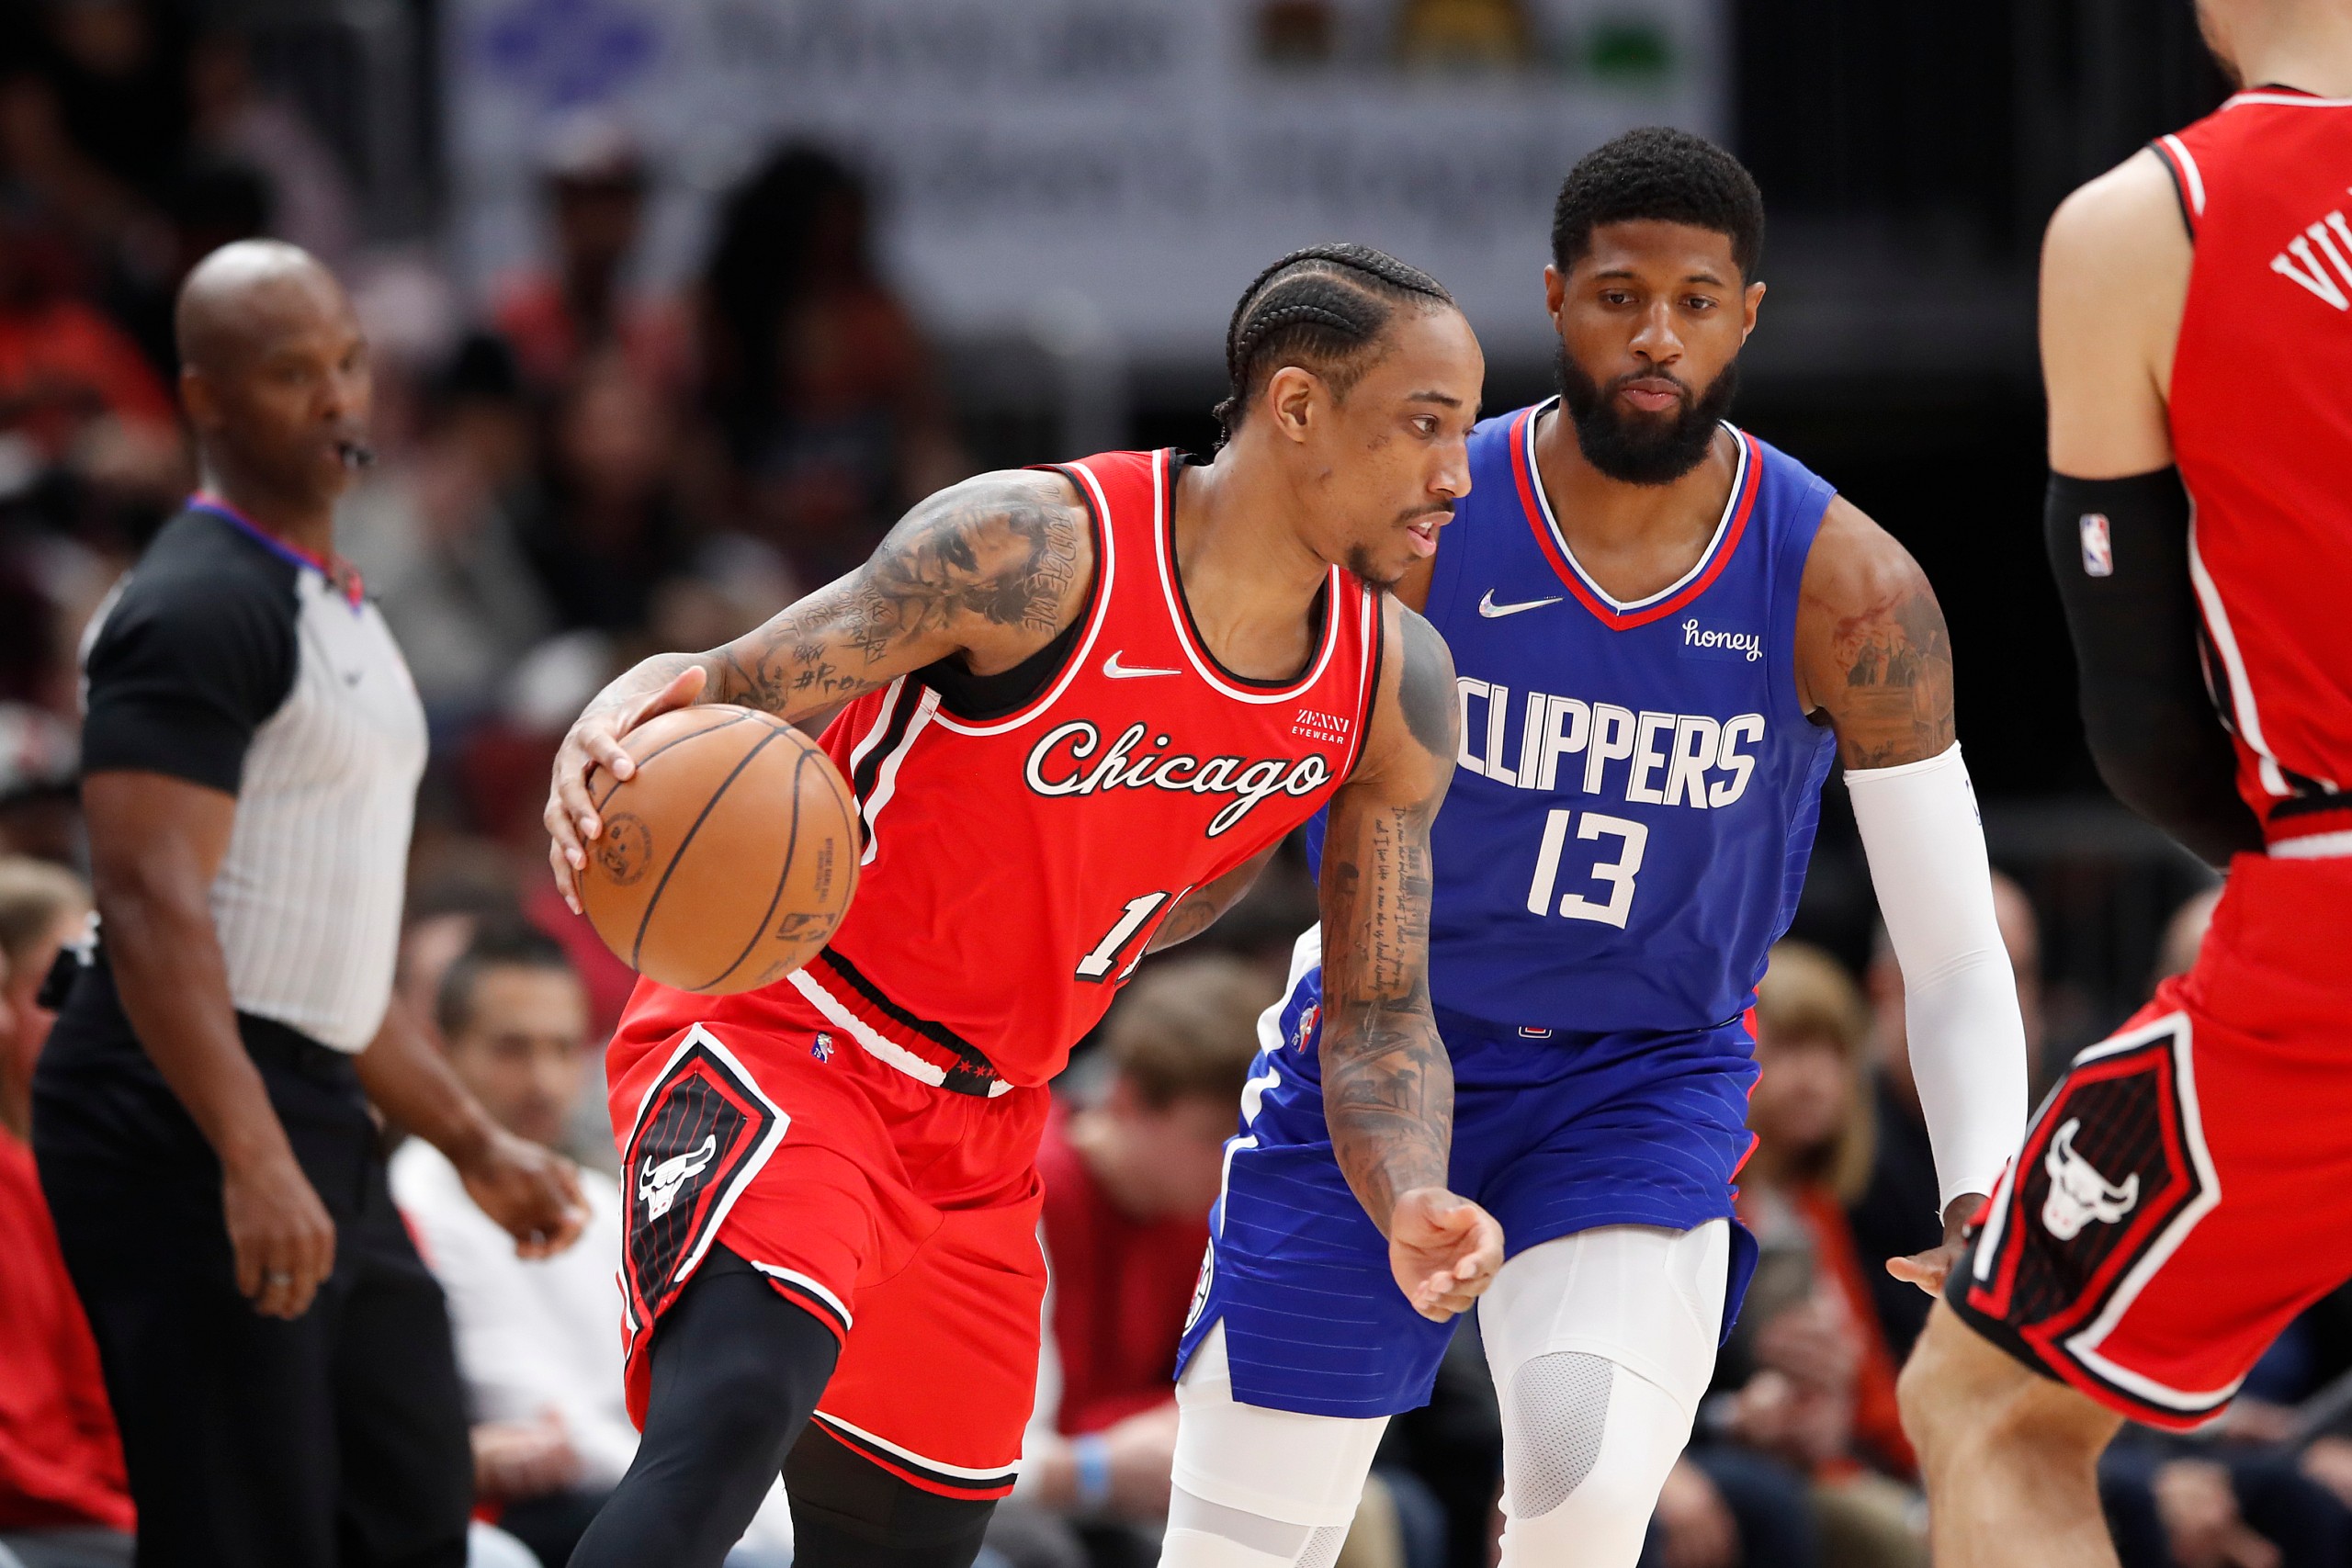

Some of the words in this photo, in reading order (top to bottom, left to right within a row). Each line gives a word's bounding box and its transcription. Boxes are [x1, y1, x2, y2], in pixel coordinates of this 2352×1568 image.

[1682, 619, 1763, 661] honey
[1291, 726, 1344, 745] EYEWEAR
[1295, 709, 1350, 733] ZENNI
[1456, 676, 1766, 809] CLIPPERS
[1023, 718, 1335, 838] Chicago
[1527, 809, 1649, 930] 13
[1074, 882, 1197, 987] 1
